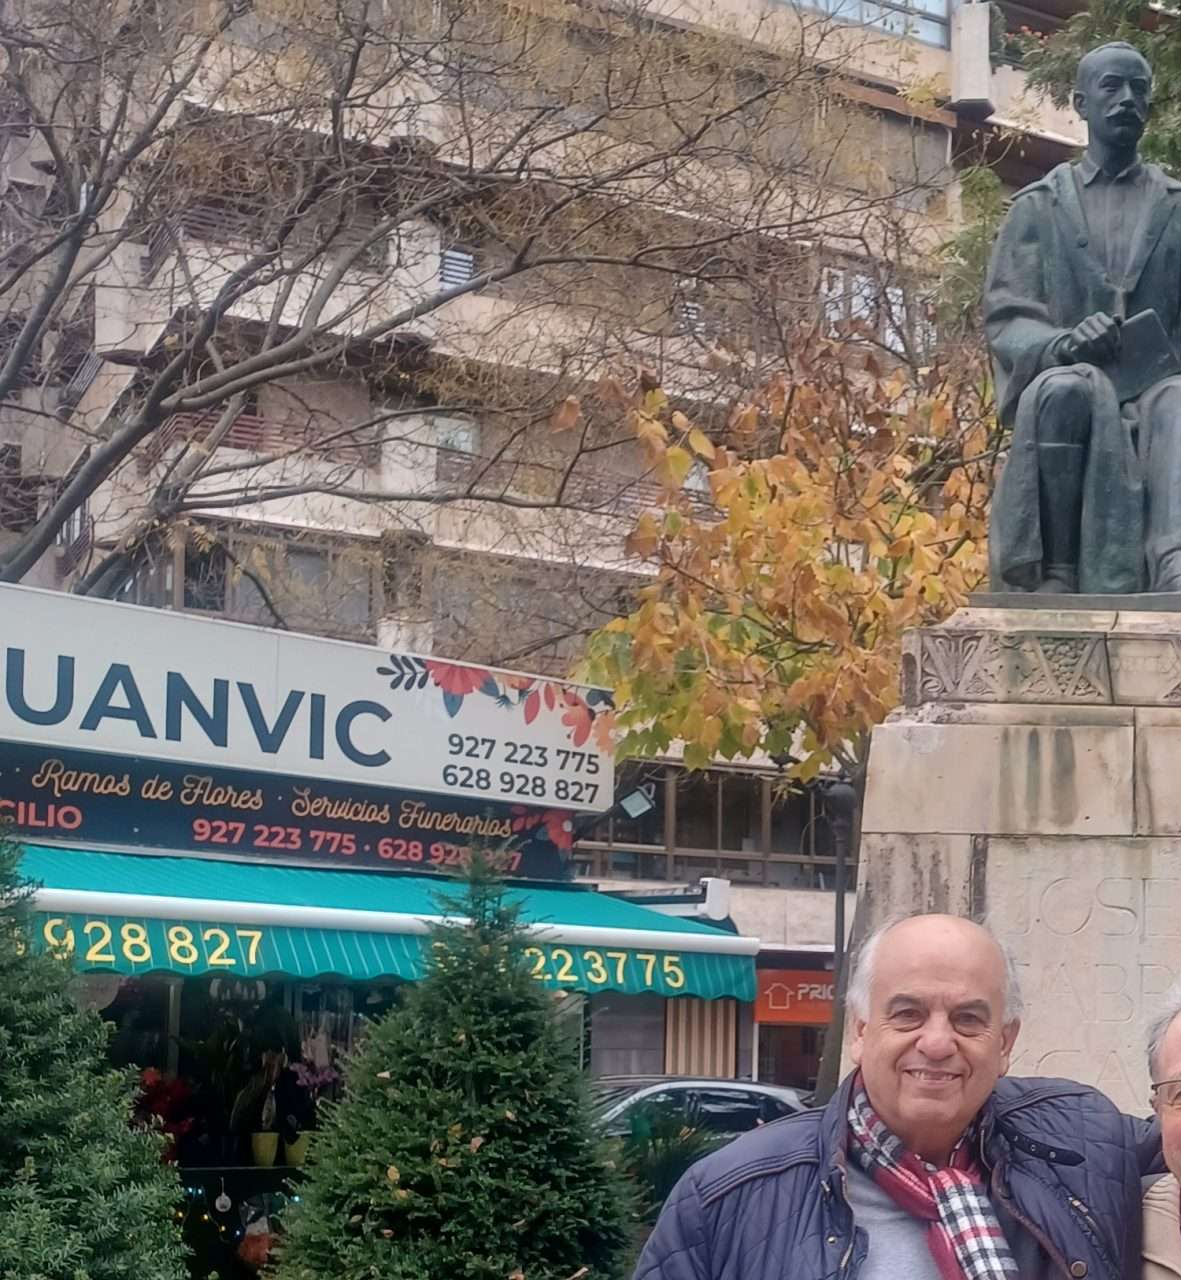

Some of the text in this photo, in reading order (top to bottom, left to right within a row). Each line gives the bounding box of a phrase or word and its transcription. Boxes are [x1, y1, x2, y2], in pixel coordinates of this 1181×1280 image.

[6, 647, 393, 767] UANVIC
[448, 733, 600, 775] 927 223 775
[31, 759, 512, 838] Ramos de Flores Servicios Funerarios
[442, 764, 599, 804] 628 928 827
[192, 819, 245, 844] 927
[253, 825, 301, 850] 223
[309, 830, 357, 855] 775
[377, 837, 423, 862] 628
